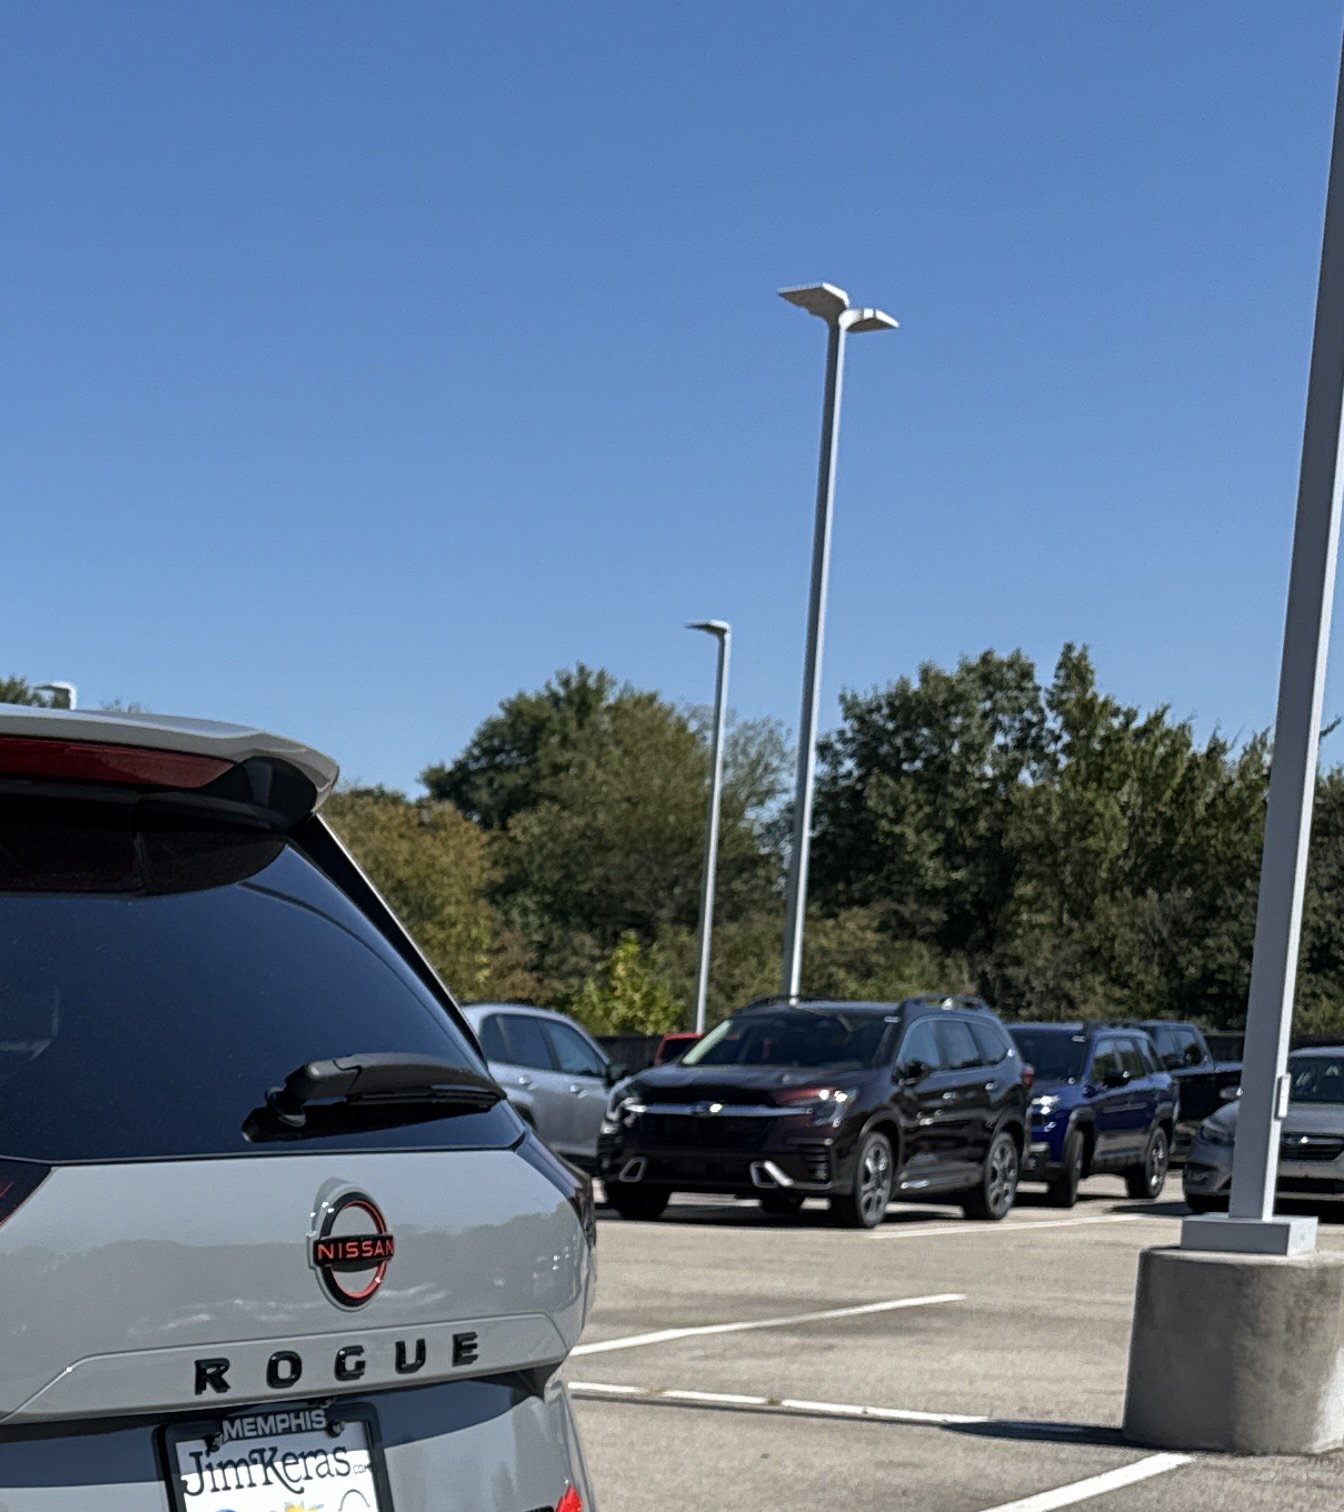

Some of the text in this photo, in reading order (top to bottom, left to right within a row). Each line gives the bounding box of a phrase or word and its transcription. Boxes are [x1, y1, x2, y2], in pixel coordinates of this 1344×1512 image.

[317, 1235, 394, 1260] NISSAN
[194, 1331, 479, 1395] ROGUE
[221, 1409, 327, 1441] MEMPHIS
